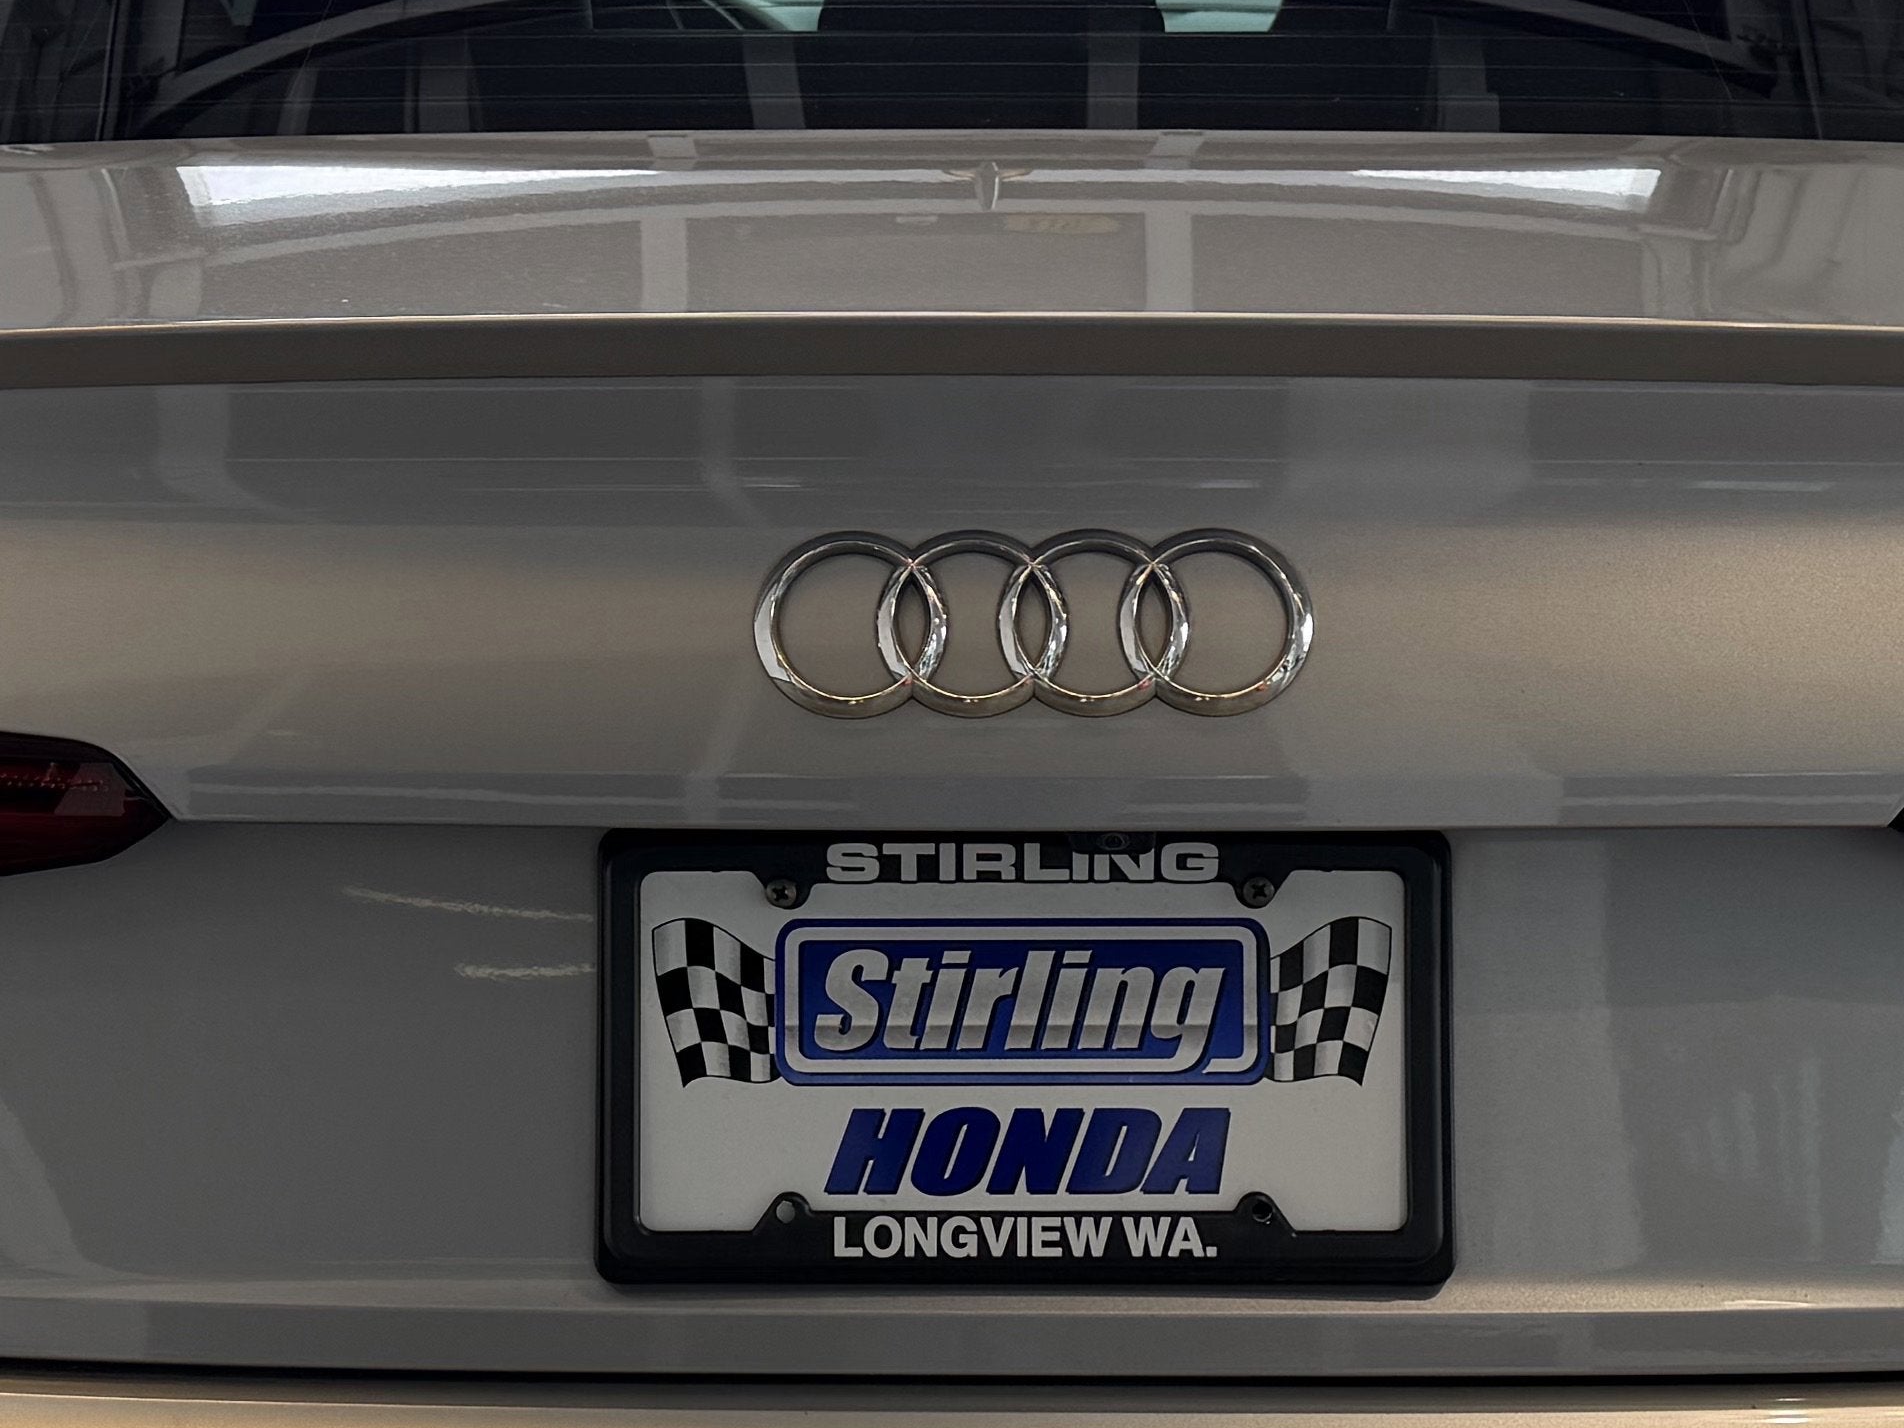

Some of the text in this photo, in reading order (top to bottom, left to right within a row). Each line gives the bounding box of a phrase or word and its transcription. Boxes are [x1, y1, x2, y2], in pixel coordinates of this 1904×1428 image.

[825, 841, 1220, 882] STIRLING
[813, 948, 1227, 1073] Stirling
[823, 1106, 1232, 1197] HONDA
[833, 1215, 1218, 1259] LONGVIEW WA.
